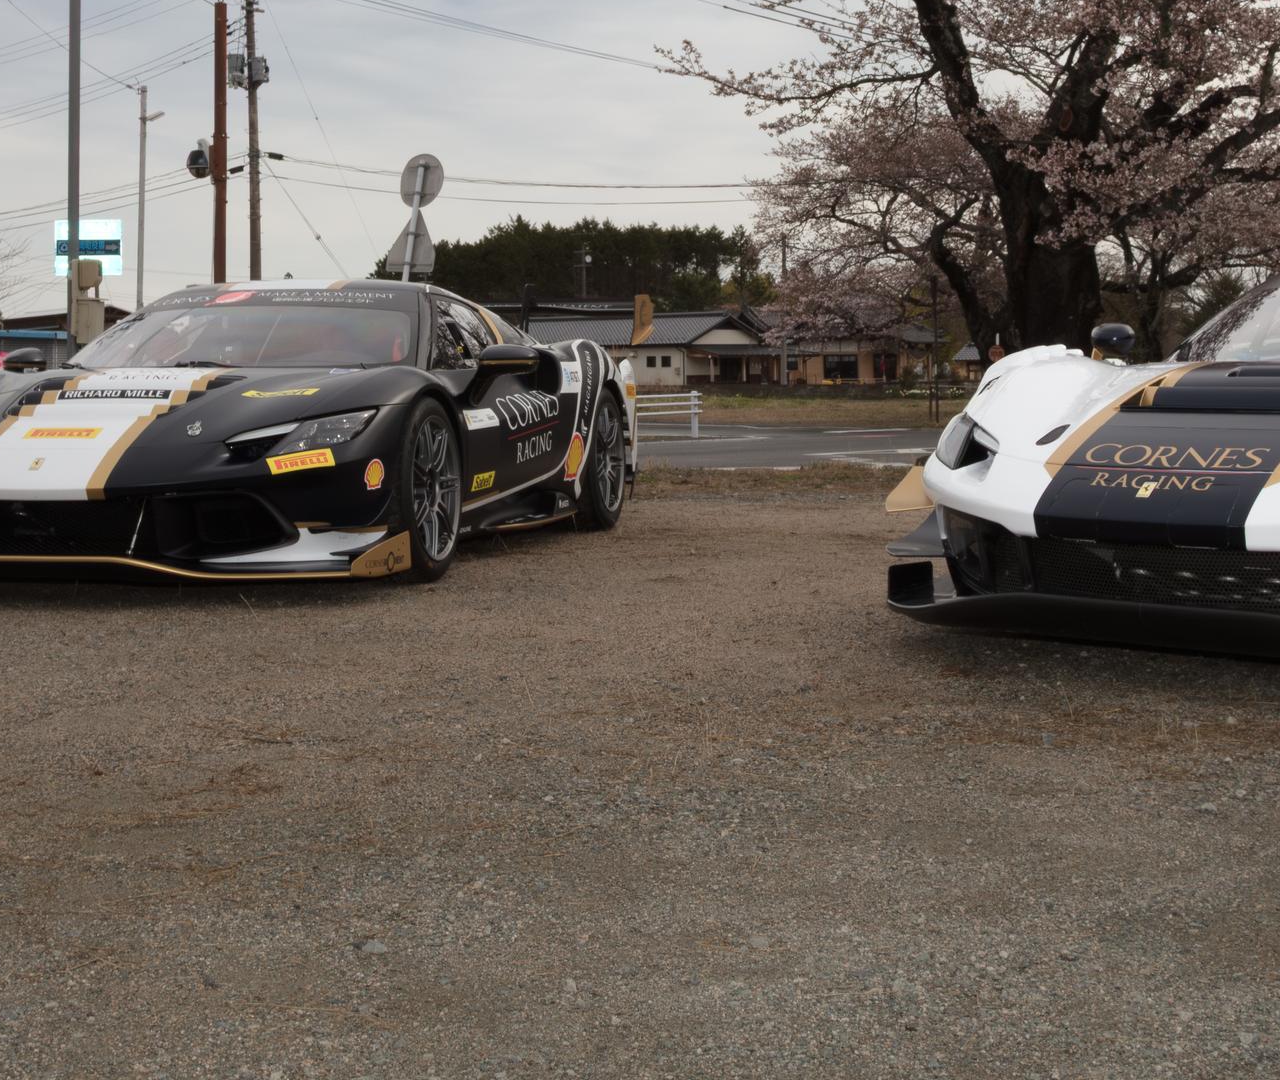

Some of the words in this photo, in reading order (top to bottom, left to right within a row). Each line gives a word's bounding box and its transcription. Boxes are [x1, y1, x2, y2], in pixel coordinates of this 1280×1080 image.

[314, 291, 397, 299] MOVEMENT
[65, 390, 121, 399] RICHARD
[125, 390, 164, 399] MILLE
[496, 390, 560, 430] CORNES
[516, 431, 553, 464] RACING
[1085, 442, 1271, 469] CORNES
[273, 452, 329, 471] PIRELLI
[1090, 473, 1215, 491] RACING
